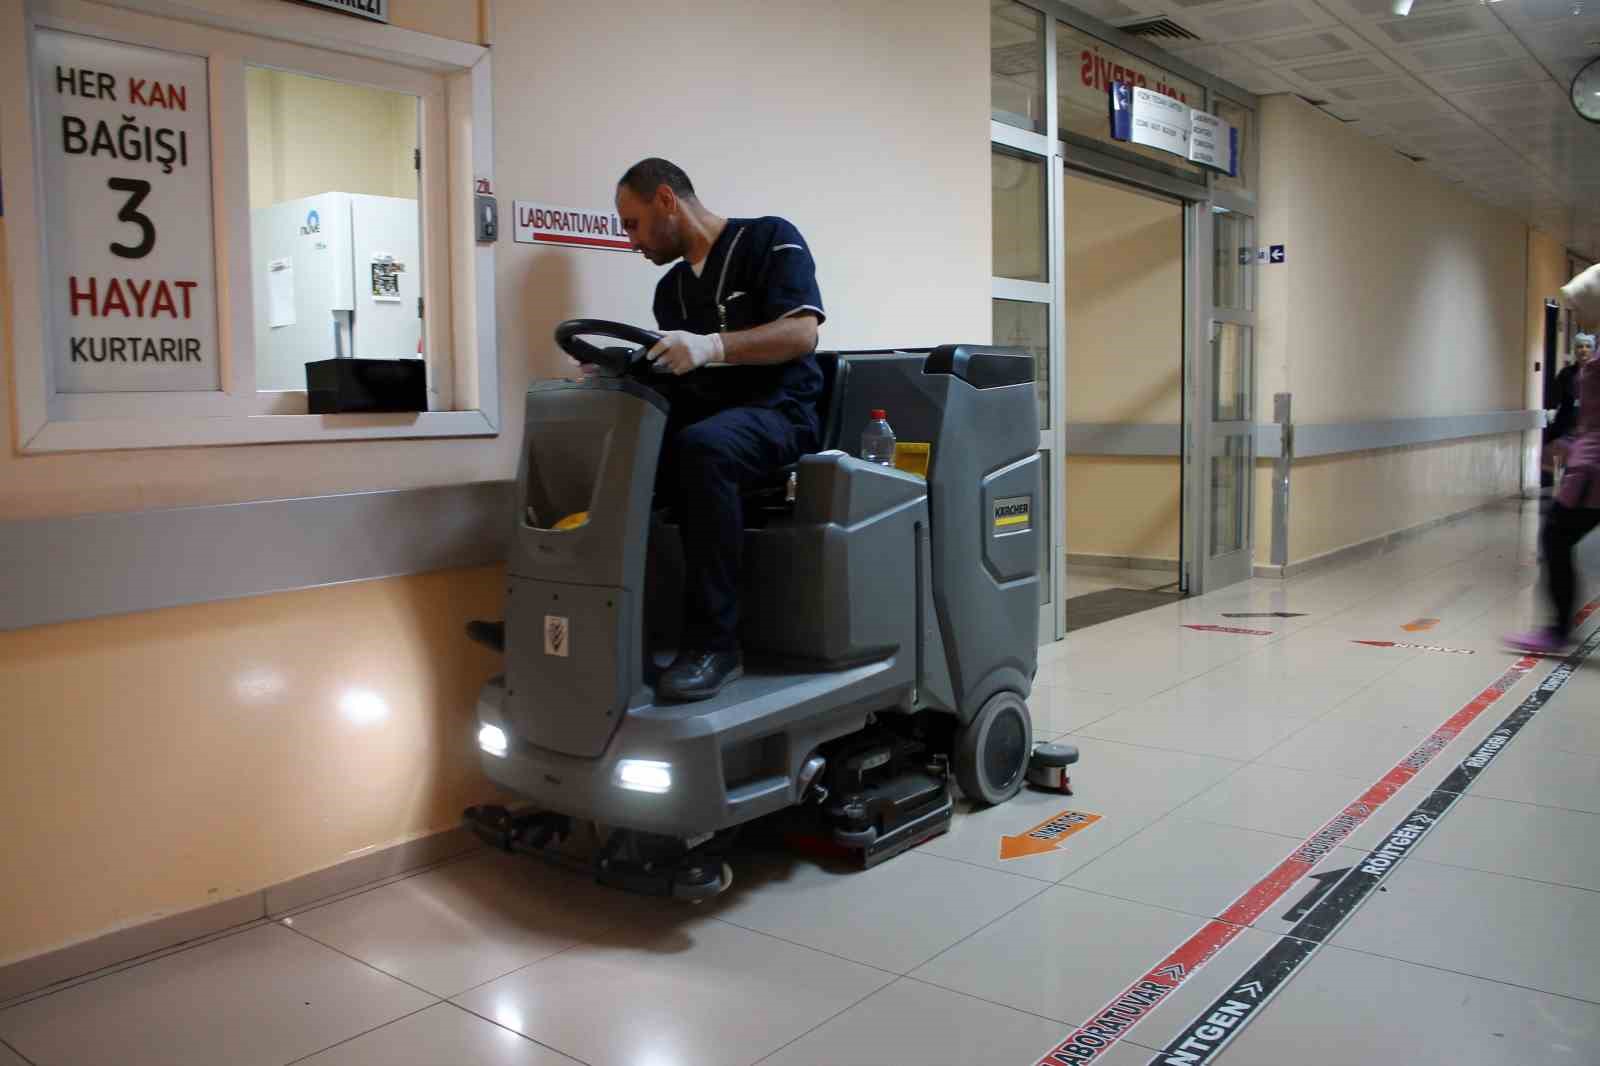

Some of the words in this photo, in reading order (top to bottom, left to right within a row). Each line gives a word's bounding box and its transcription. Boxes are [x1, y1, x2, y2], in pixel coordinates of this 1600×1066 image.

[56, 65, 117, 101] HER
[128, 77, 187, 111] KAN
[61, 114, 187, 174] BAĞIŞI
[107, 176, 156, 259] 3
[520, 207, 609, 235] LABORATUVAR
[69, 276, 198, 319] HAYAT
[70, 336, 202, 363] KURTARIR
[1361, 824, 1425, 875] RÖNTGEN
[1041, 980, 1170, 1066] ABORATUVAR
